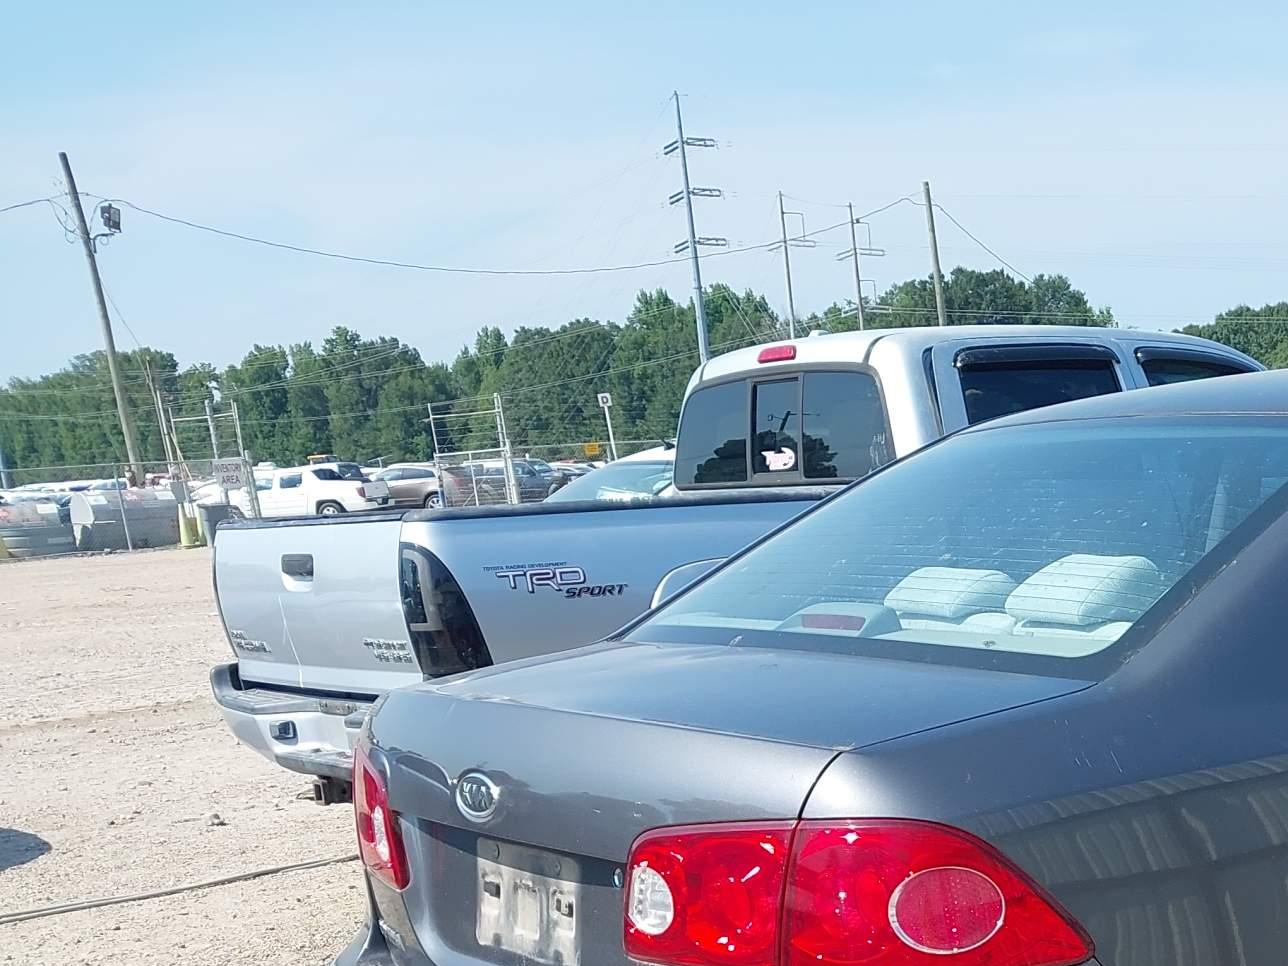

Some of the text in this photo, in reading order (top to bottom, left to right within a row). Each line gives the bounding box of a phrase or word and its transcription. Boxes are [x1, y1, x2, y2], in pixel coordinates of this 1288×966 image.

[600, 396, 609, 405] D
[222, 475, 241, 484] AREA
[528, 561, 568, 569] DEVELOPMENT
[495, 566, 587, 594] TRD
[564, 584, 628, 599] SPORT
